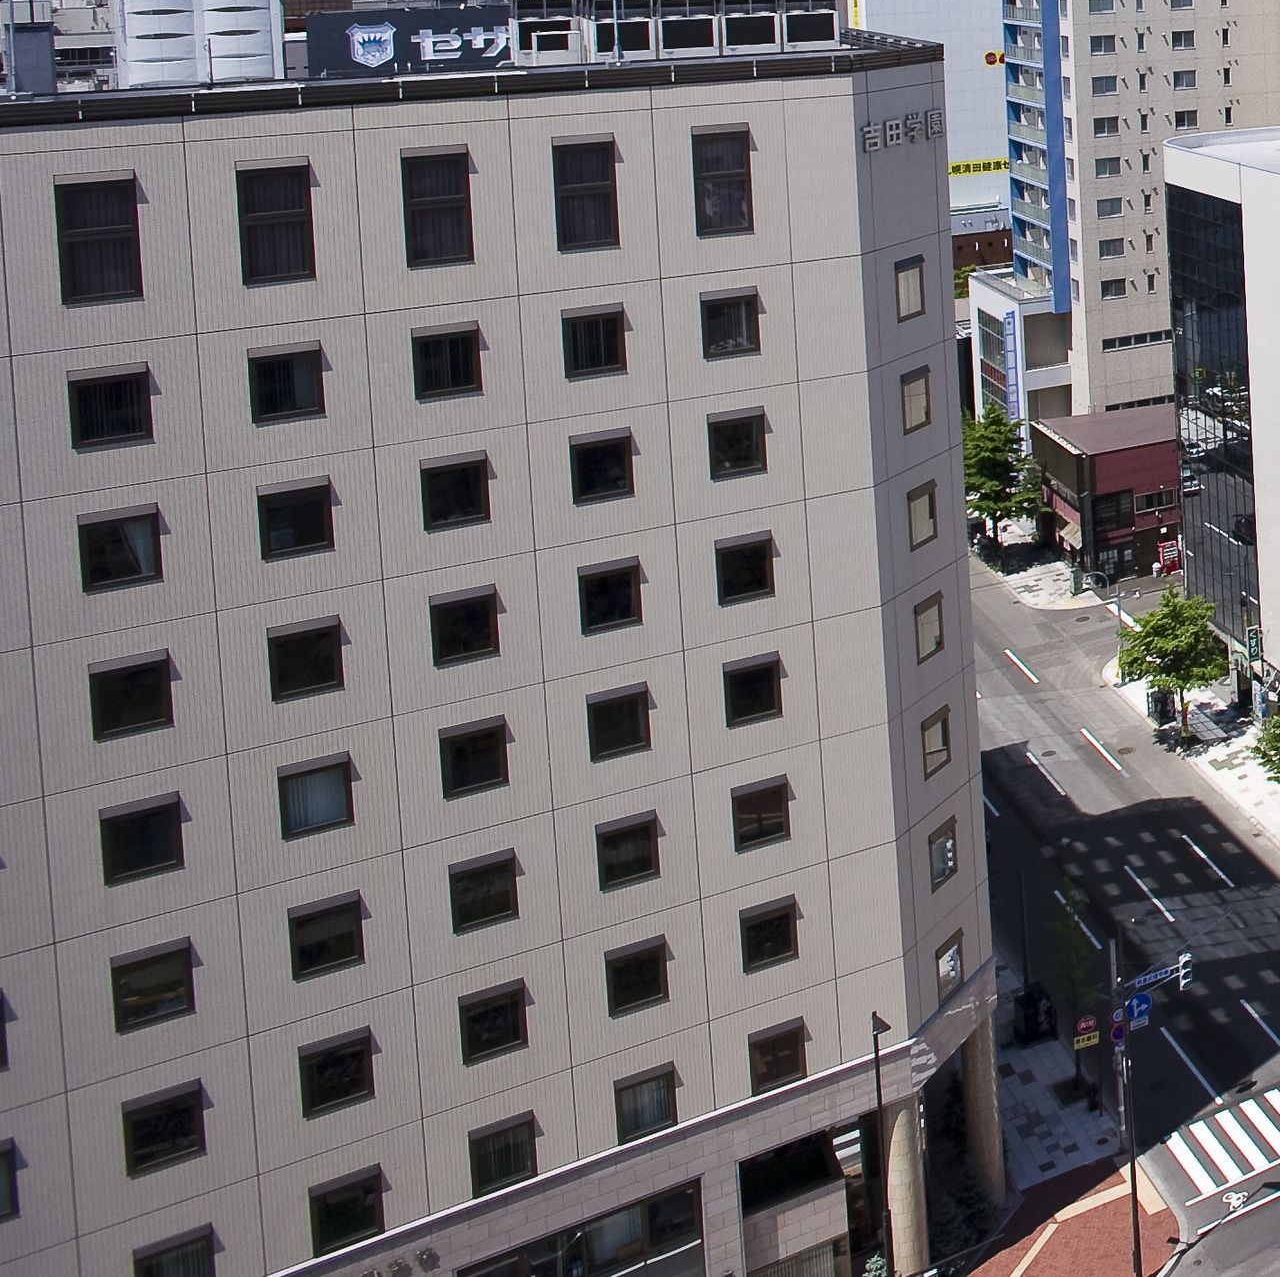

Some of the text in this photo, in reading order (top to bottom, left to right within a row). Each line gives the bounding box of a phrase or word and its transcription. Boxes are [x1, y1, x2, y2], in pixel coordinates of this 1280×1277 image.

[862, 109, 944, 153] 吉田学園
[948, 160, 1009, 175] 幌清田健康セ
[1249, 630, 1258, 656] くすり
